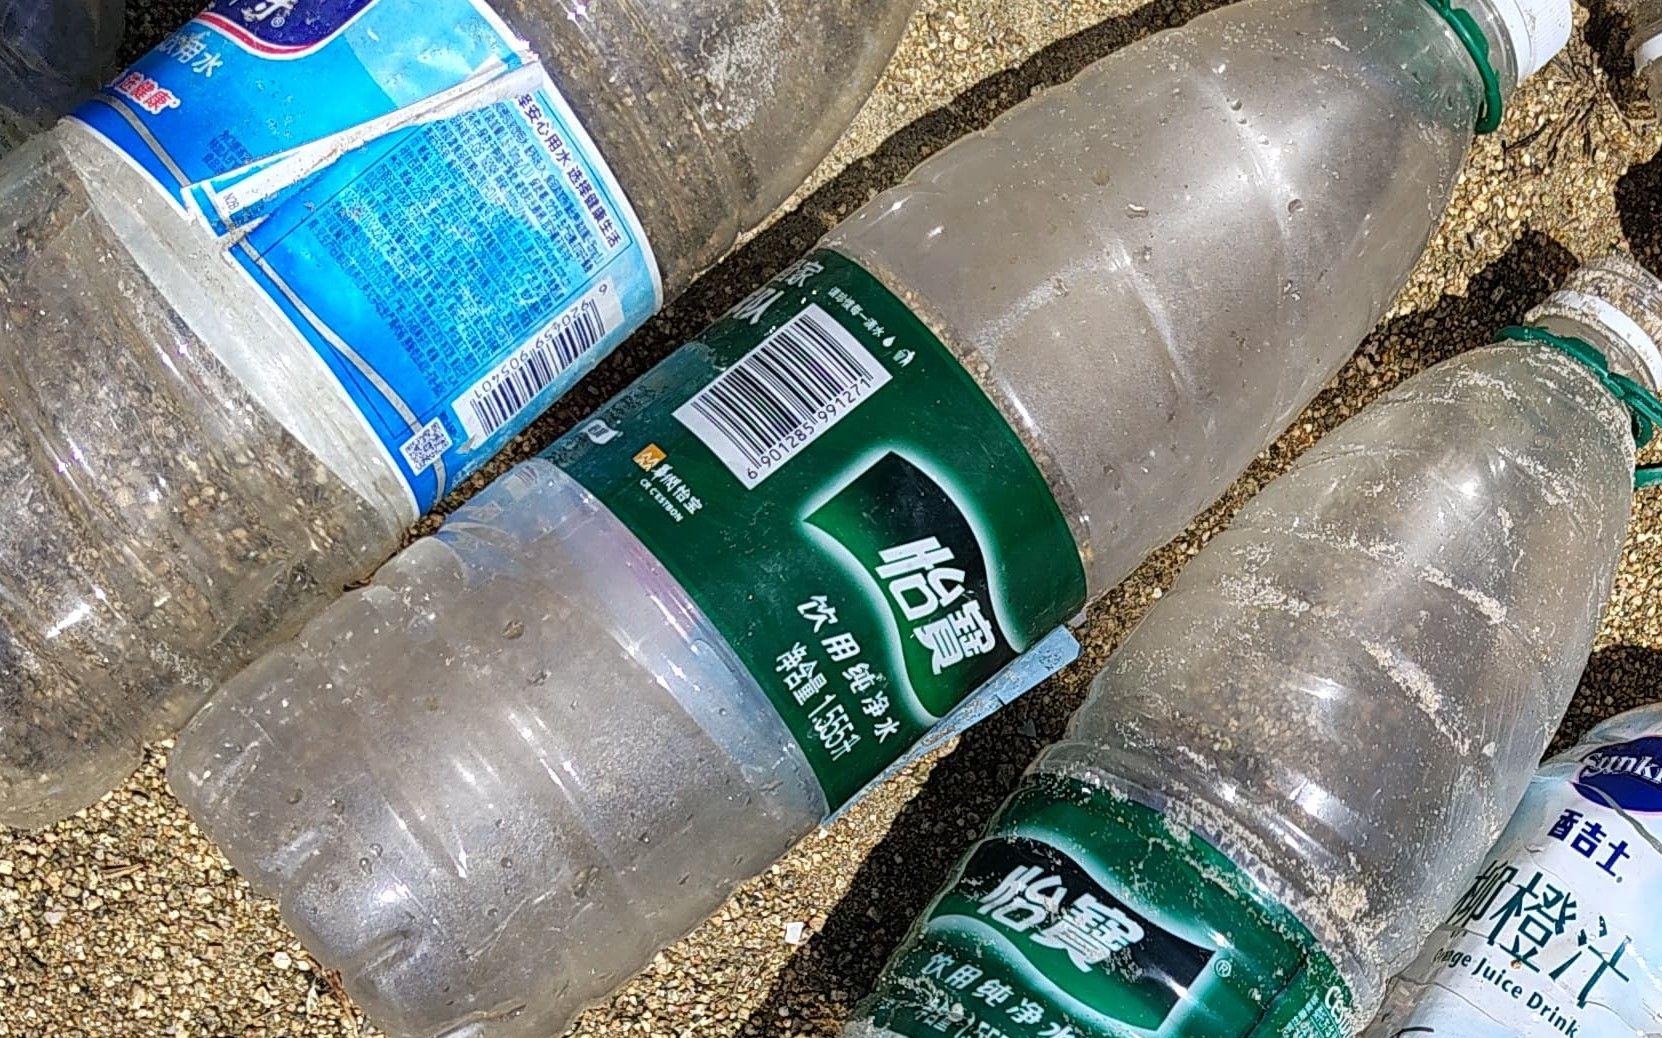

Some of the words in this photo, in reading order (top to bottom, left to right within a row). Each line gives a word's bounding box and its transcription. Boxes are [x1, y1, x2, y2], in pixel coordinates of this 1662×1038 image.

[745, 466, 760, 482] 6
[759, 421, 817, 470] 901285
[817, 377, 872, 423] 991271
[875, 535, 996, 676] 怡寶
[797, 595, 900, 744] 饮用纯净水
[977, 863, 1145, 973] 怡寶
[1433, 947, 1470, 968] nge
[1471, 958, 1523, 999] Juice
